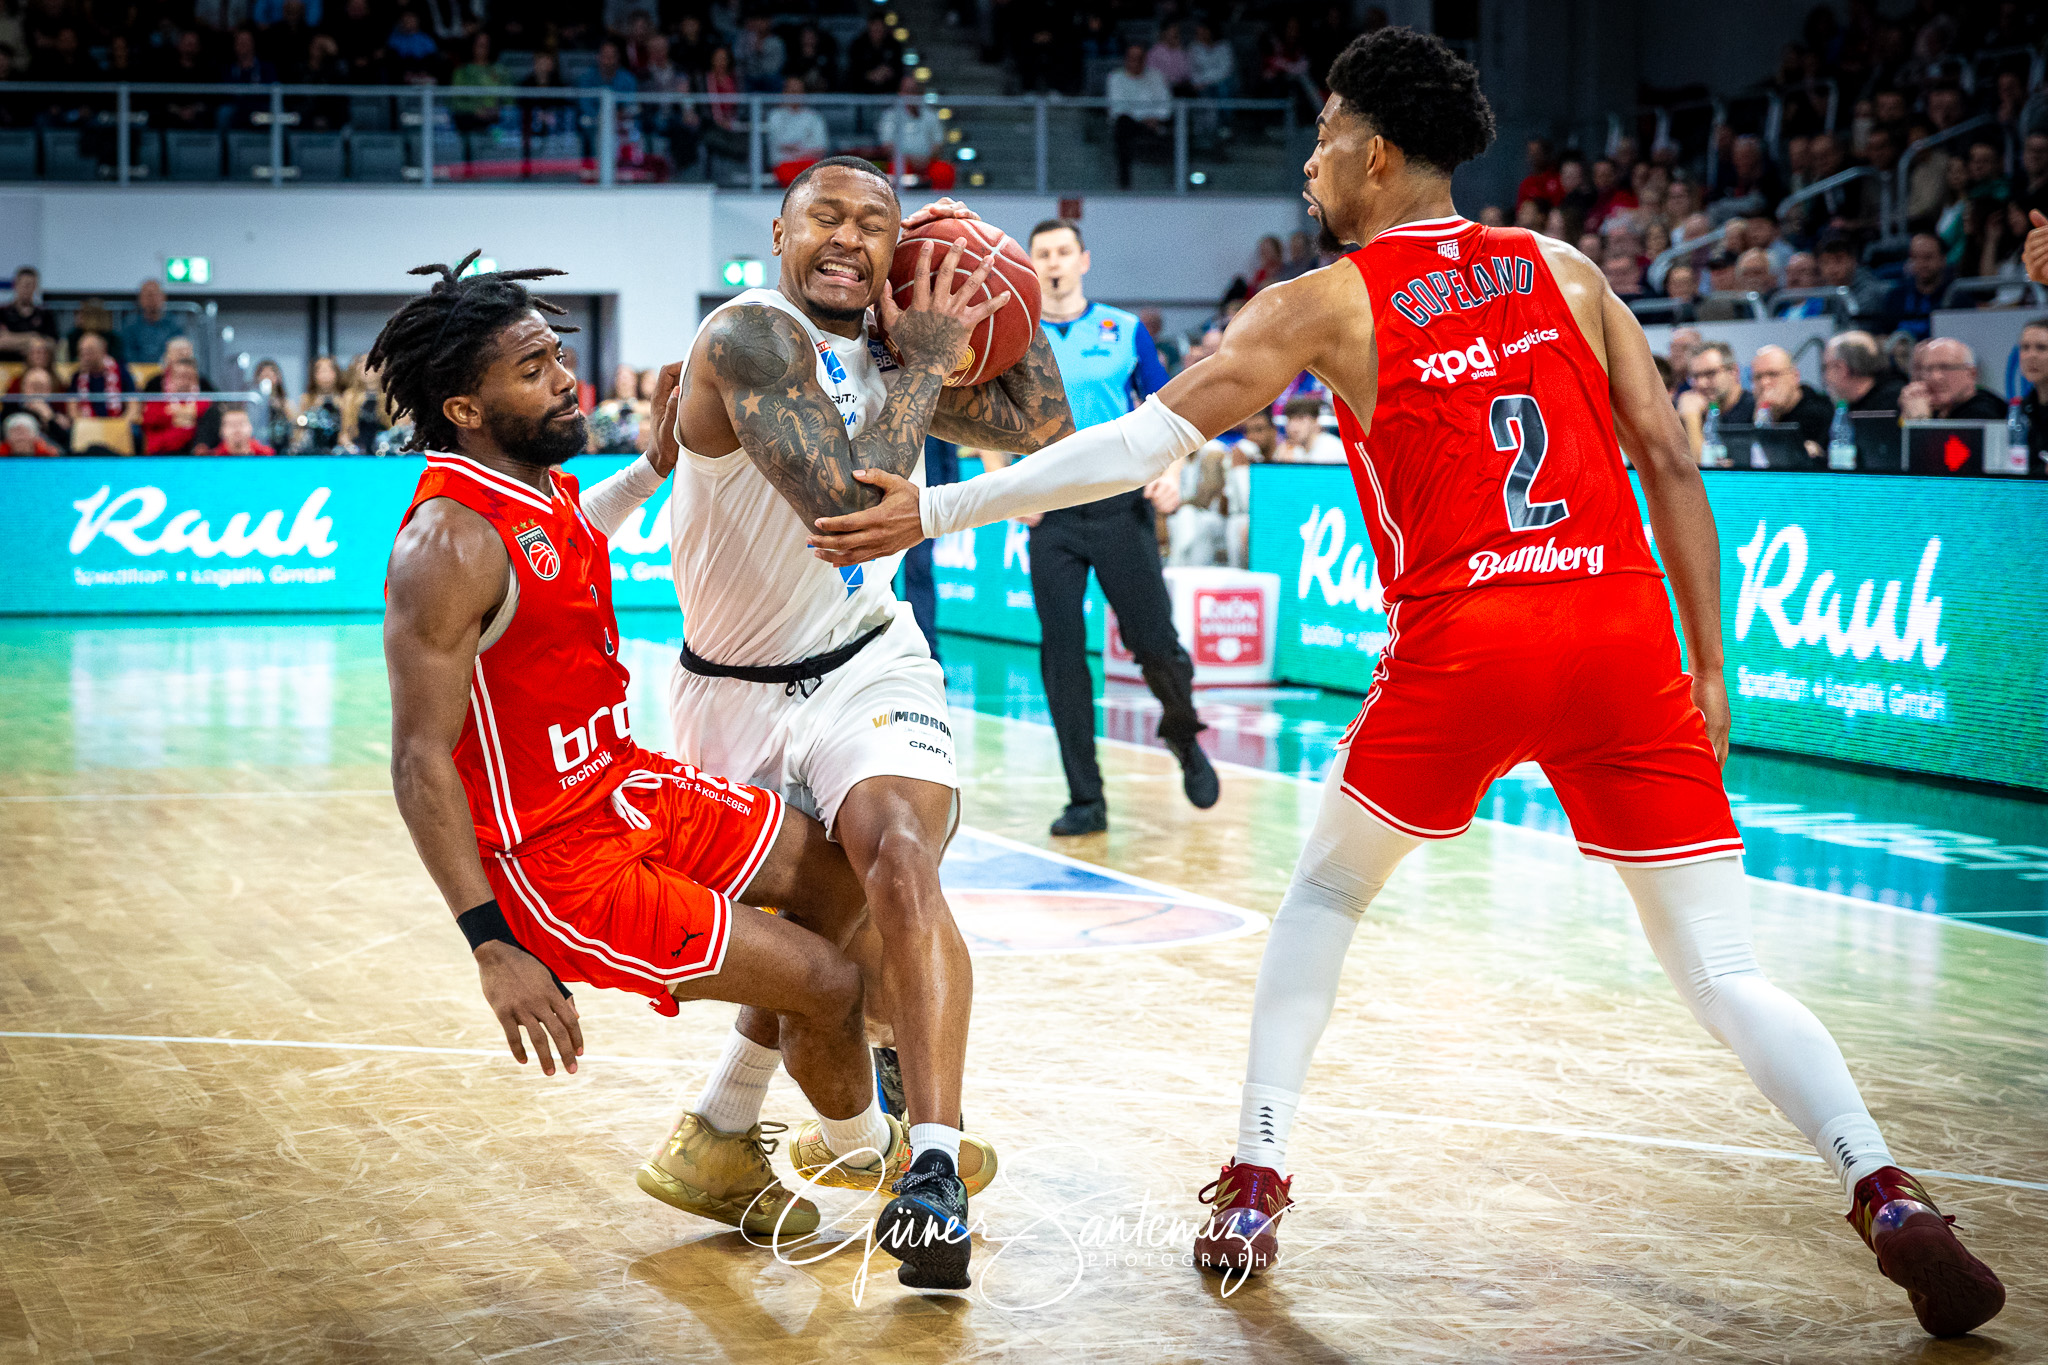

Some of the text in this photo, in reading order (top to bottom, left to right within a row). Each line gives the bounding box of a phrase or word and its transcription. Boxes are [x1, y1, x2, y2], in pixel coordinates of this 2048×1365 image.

[1391, 256, 1534, 327] COPELAND
[1413, 337, 1494, 384] xpd
[1471, 369, 1497, 380] global
[1489, 394, 1570, 532] 2
[69, 485, 338, 558] Rauh
[1467, 537, 1604, 587] Bamberg
[1735, 517, 1949, 671] Rauh
[559, 750, 613, 790] Technik
[909, 741, 947, 758] CRAFT
[694, 784, 702, 793] &
[701, 788, 751, 817] KOLLEGEN
